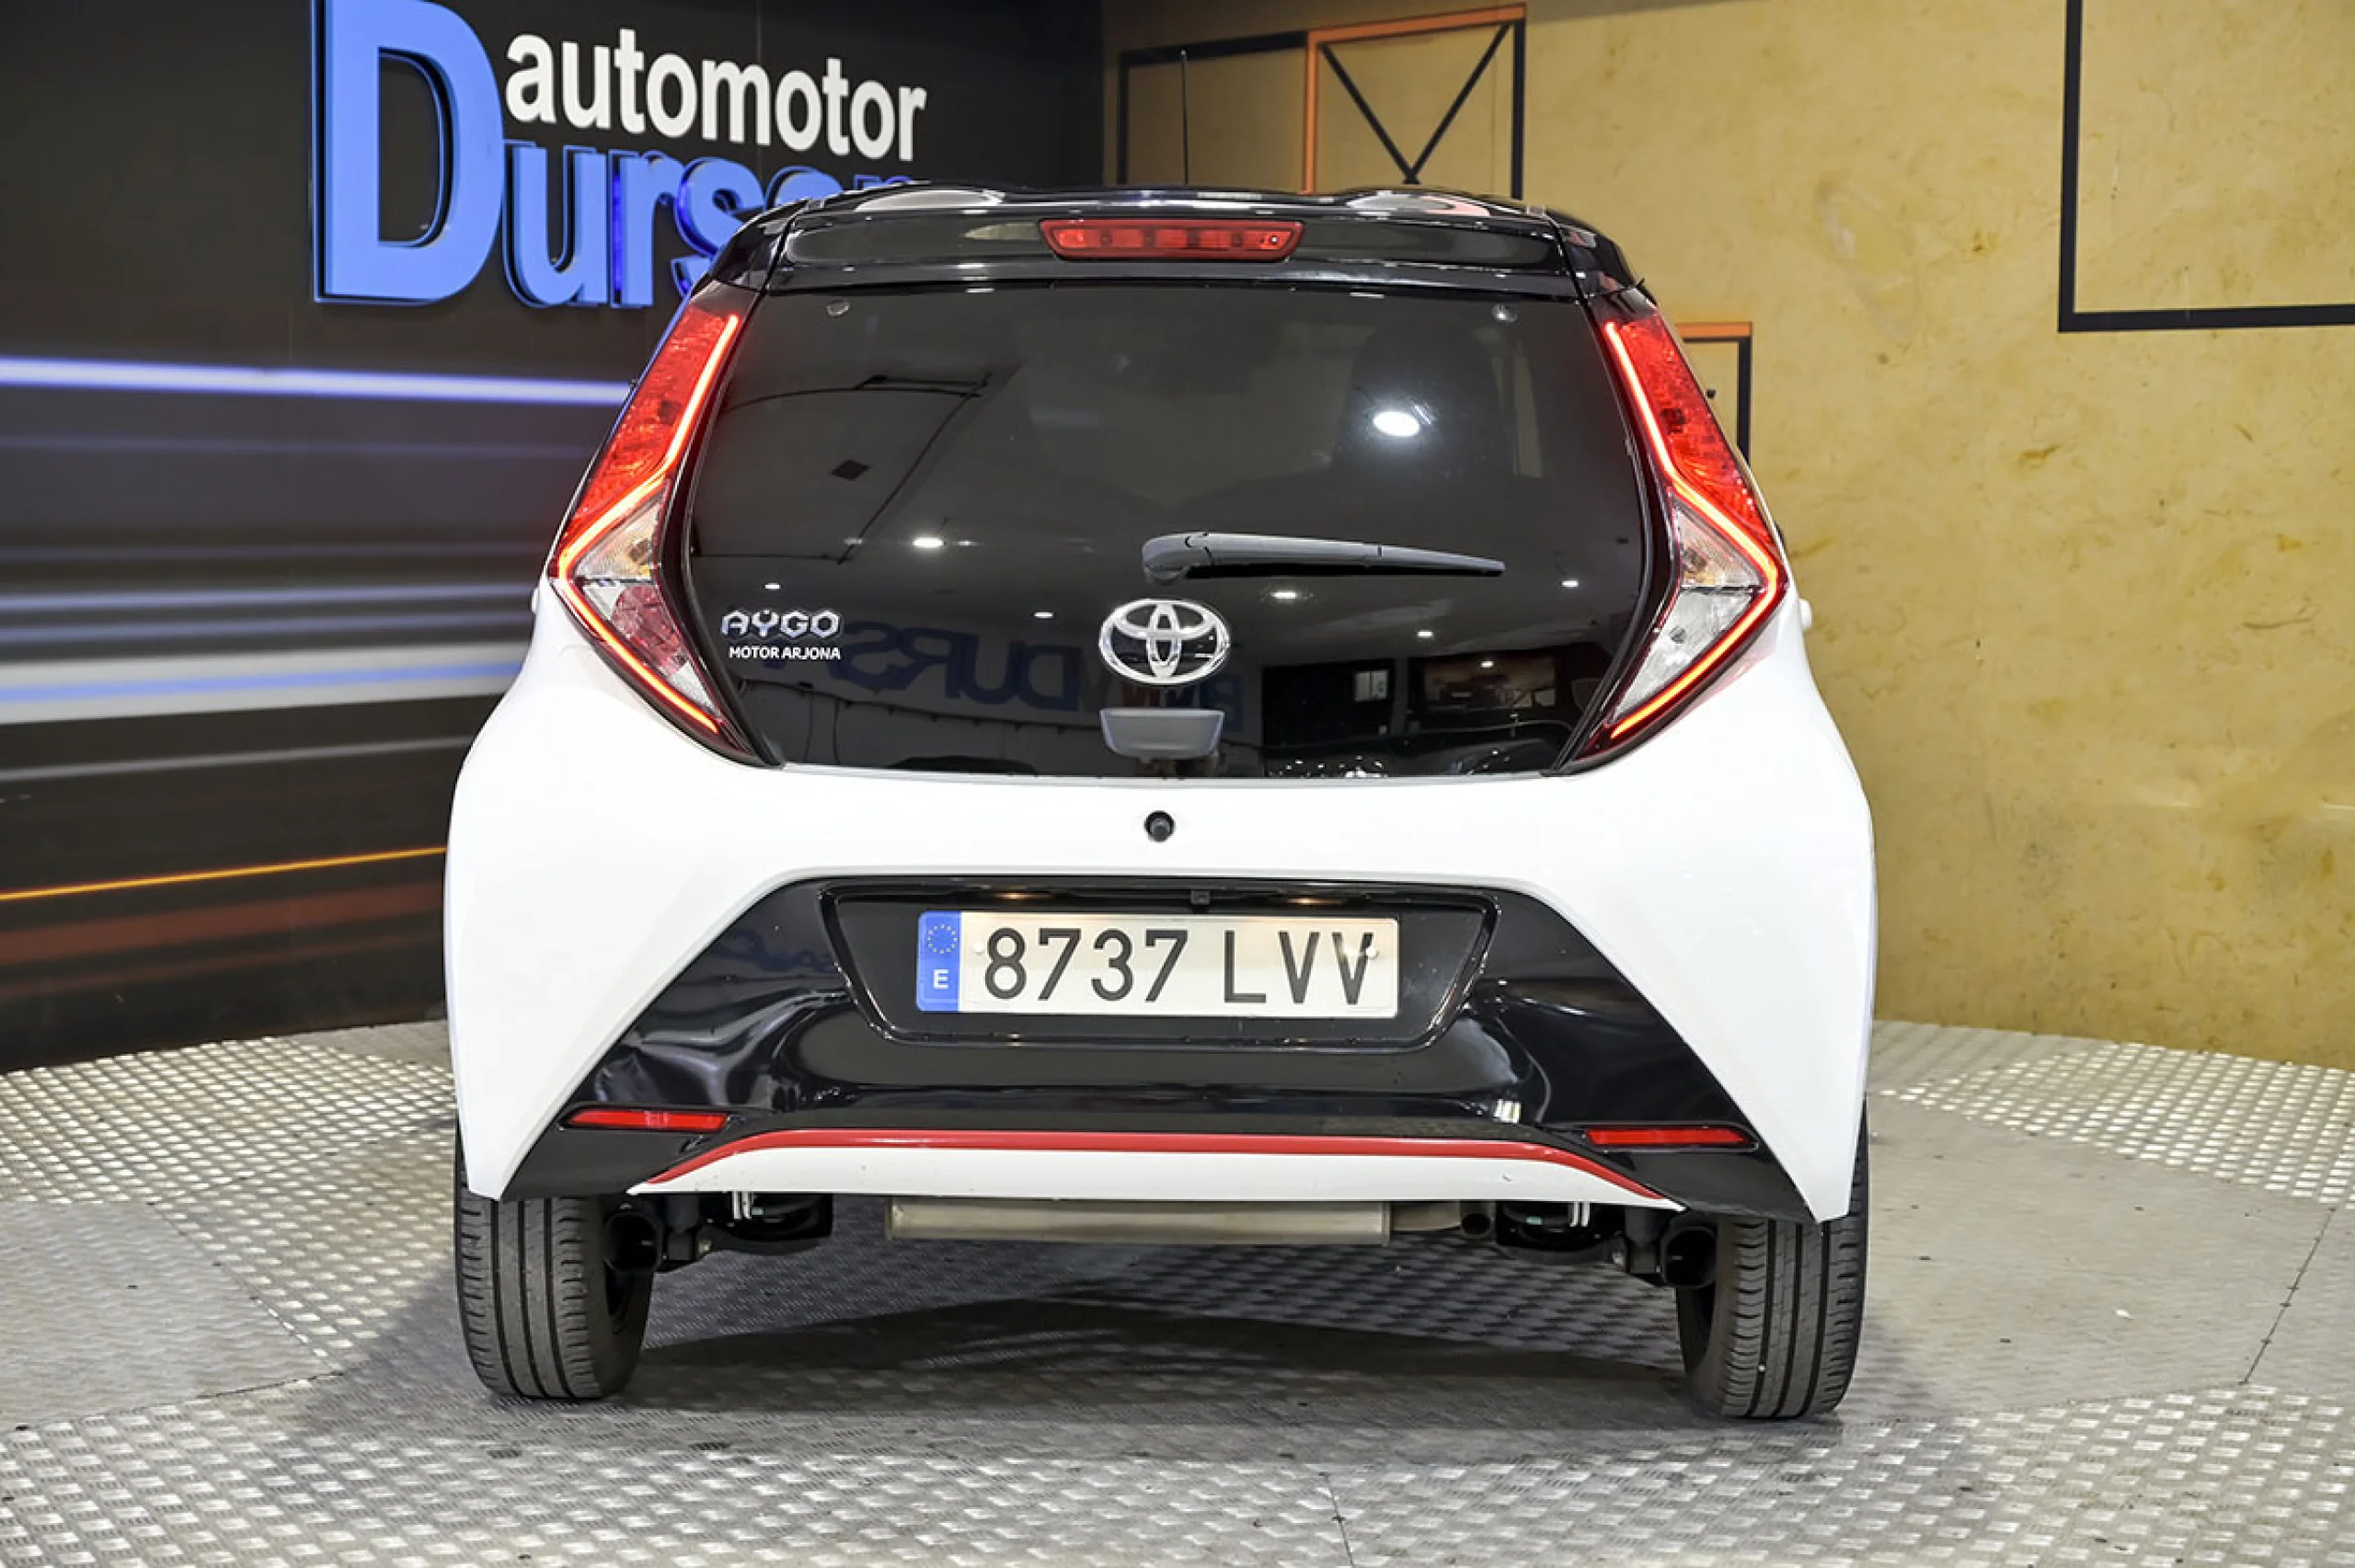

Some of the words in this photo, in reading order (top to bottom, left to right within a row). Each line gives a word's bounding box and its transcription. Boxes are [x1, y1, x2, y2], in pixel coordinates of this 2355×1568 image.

[505, 29, 926, 162] automotor
[314, 0, 915, 307] Durs
[721, 609, 840, 639] AYGO
[729, 646, 780, 660] MOTOR
[781, 646, 842, 660] ARJONA
[933, 968, 949, 990] E
[984, 926, 1189, 1002] 8737
[1223, 929, 1375, 1006] LVV
